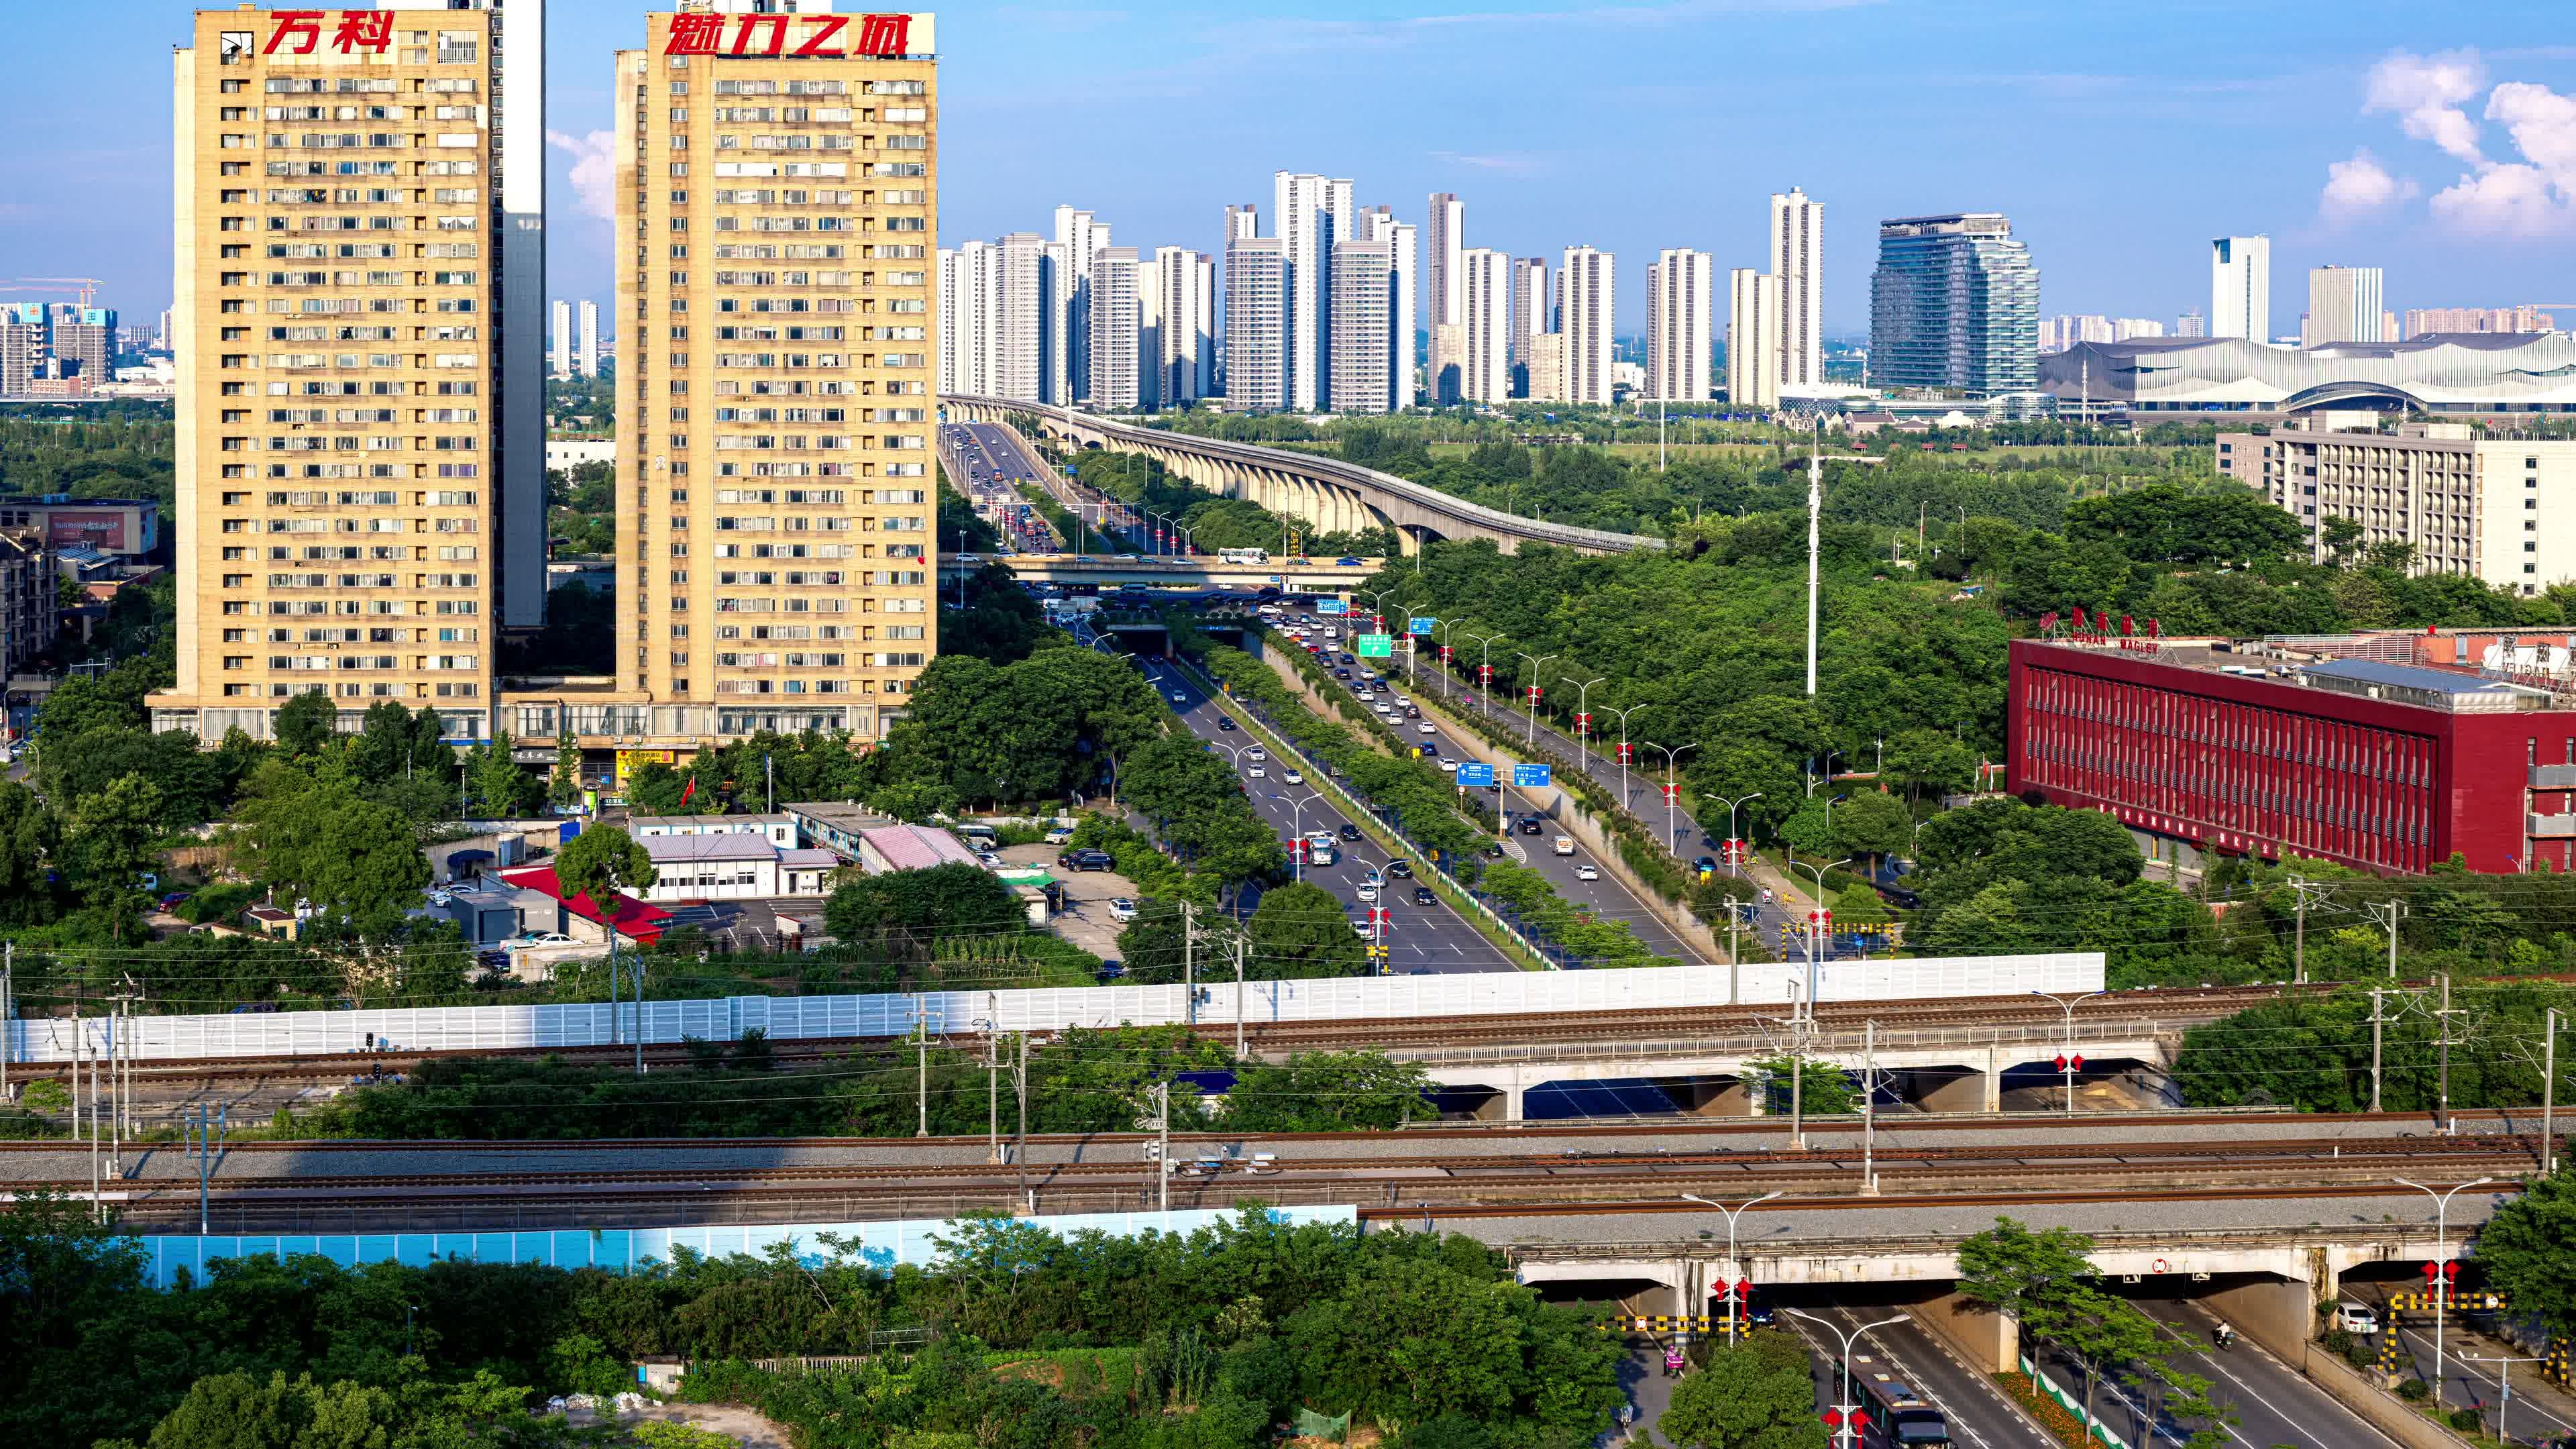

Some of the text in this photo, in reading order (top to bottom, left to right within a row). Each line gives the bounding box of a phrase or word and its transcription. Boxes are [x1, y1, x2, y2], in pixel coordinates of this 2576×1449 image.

[262, 11, 395, 54] 万科
[664, 12, 912, 55] 魅力之城
[2072, 631, 2158, 654] HUNAN MAGLEV
